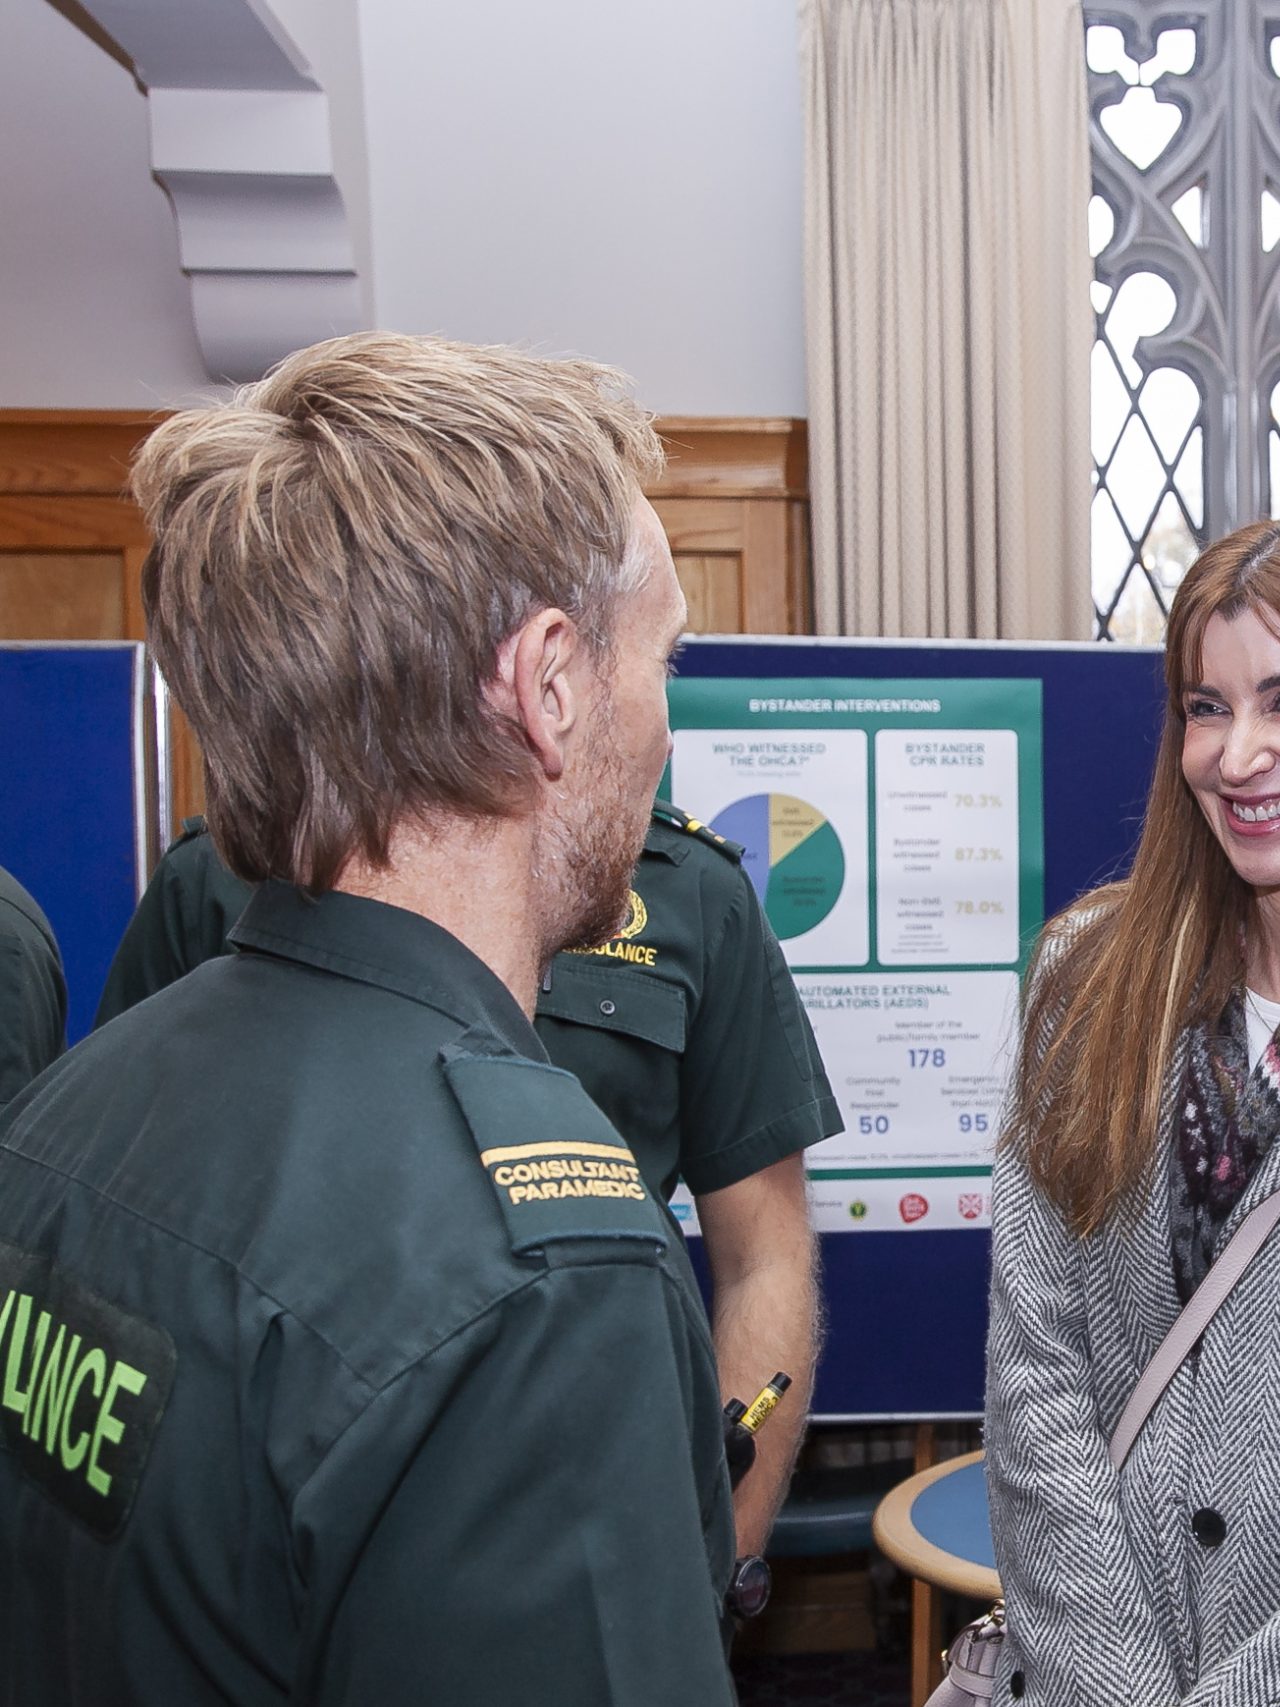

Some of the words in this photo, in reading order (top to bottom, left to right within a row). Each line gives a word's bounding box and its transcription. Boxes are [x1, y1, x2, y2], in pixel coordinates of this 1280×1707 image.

[749, 699, 833, 713] BYSTANDER
[834, 698, 941, 713] INTERVENTIONS
[712, 743, 745, 754] WHO
[748, 742, 827, 754] WITNESSED
[905, 742, 985, 754] BYSTANDER
[730, 755, 754, 766] THE
[941, 755, 985, 767] RATES
[882, 984, 950, 997] EXTERNAL
[908, 1048, 946, 1068] 178
[859, 1114, 890, 1134] 50
[959, 1113, 988, 1132] 95
[494, 1159, 640, 1187] CONSULTANT
[508, 1179, 646, 1206] PARAMEDIC
